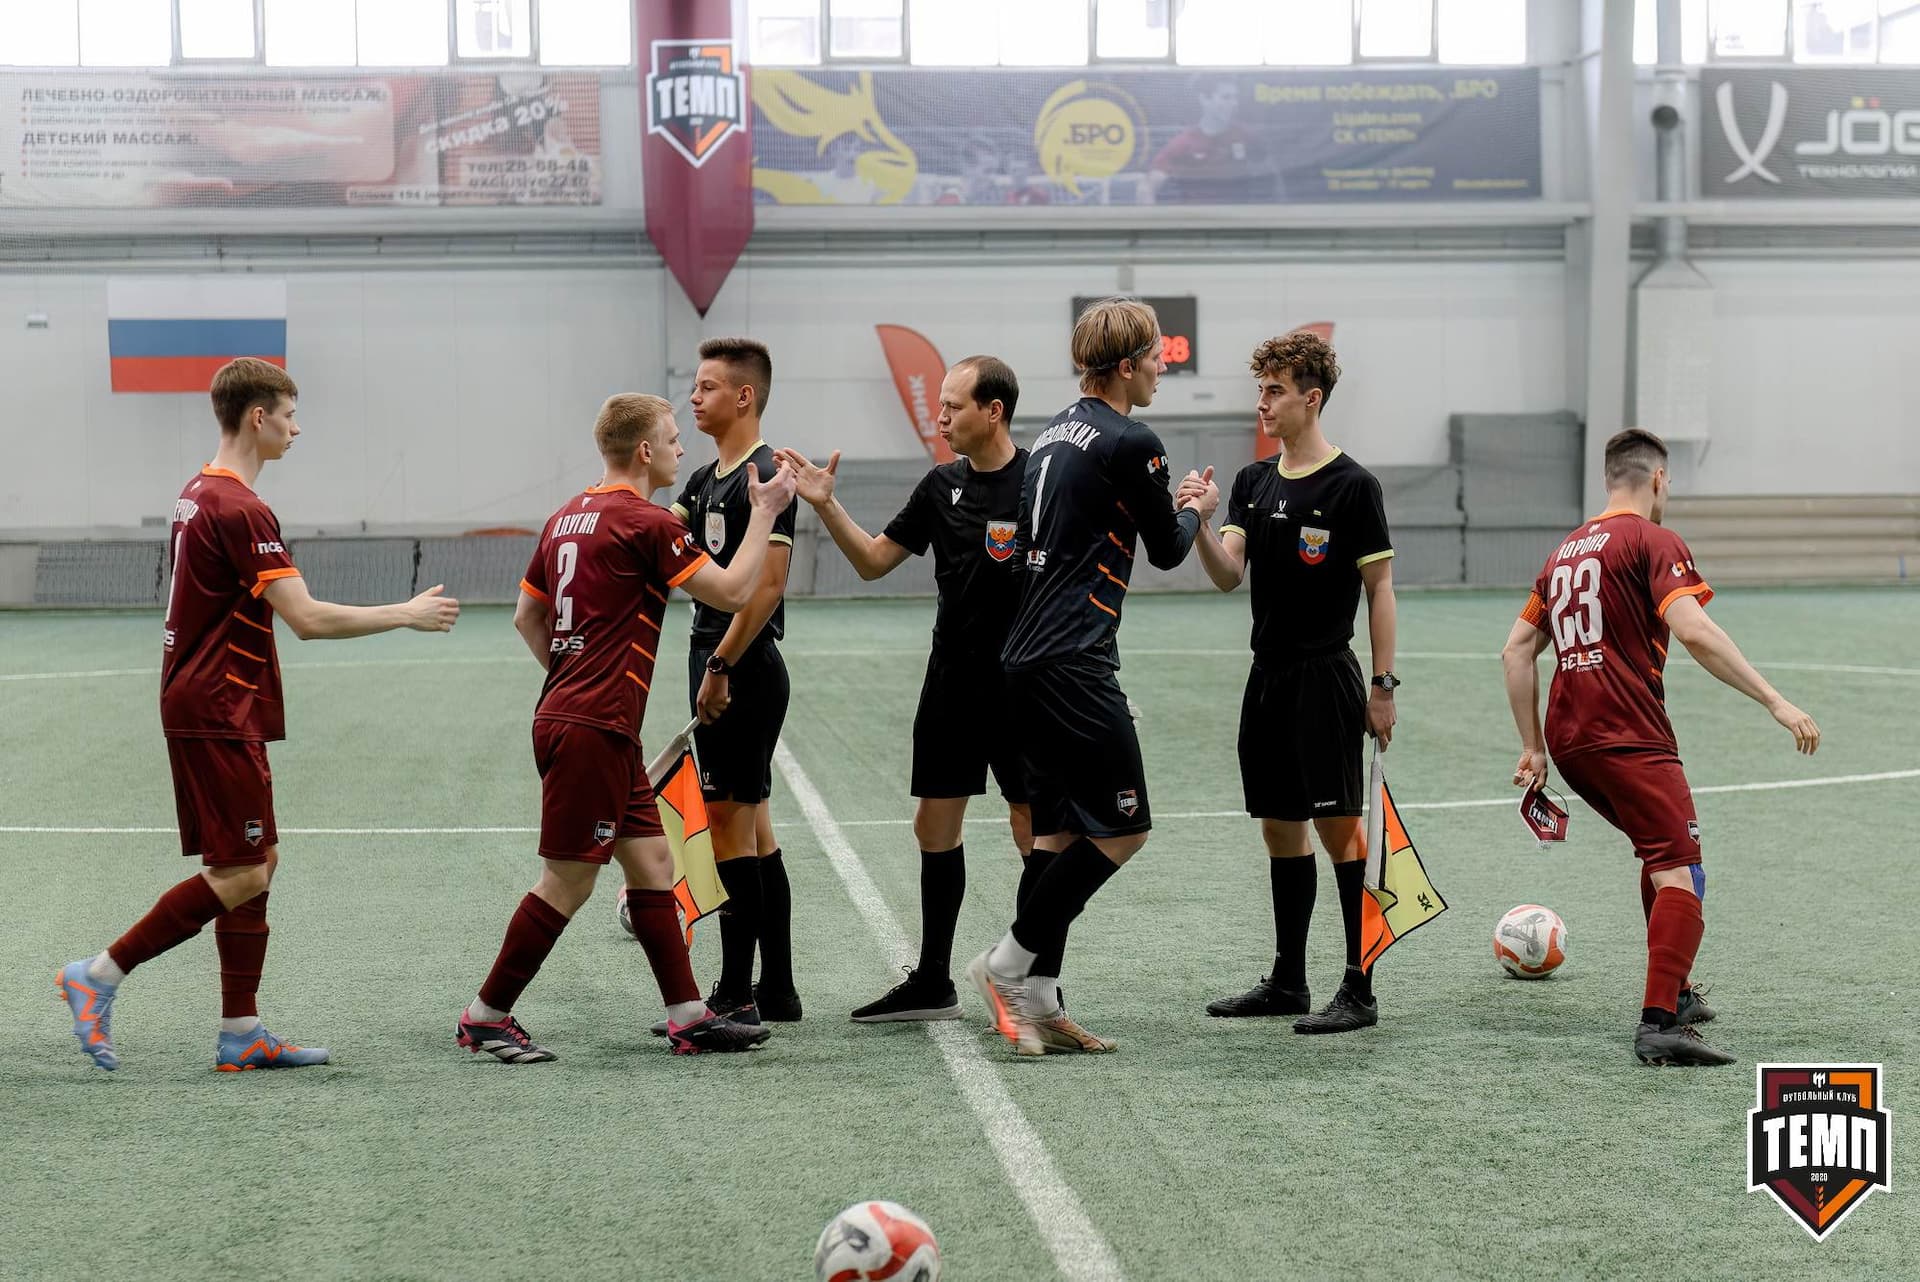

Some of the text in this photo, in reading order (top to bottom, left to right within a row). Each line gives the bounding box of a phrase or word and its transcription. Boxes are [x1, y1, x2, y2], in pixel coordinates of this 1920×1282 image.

[22, 130, 107, 146] ДЕТСКИЙ
[655, 75, 737, 120] ТЕМП
[1031, 455, 1052, 542] 1
[555, 541, 578, 631] 2
[1551, 558, 1604, 653] 23
